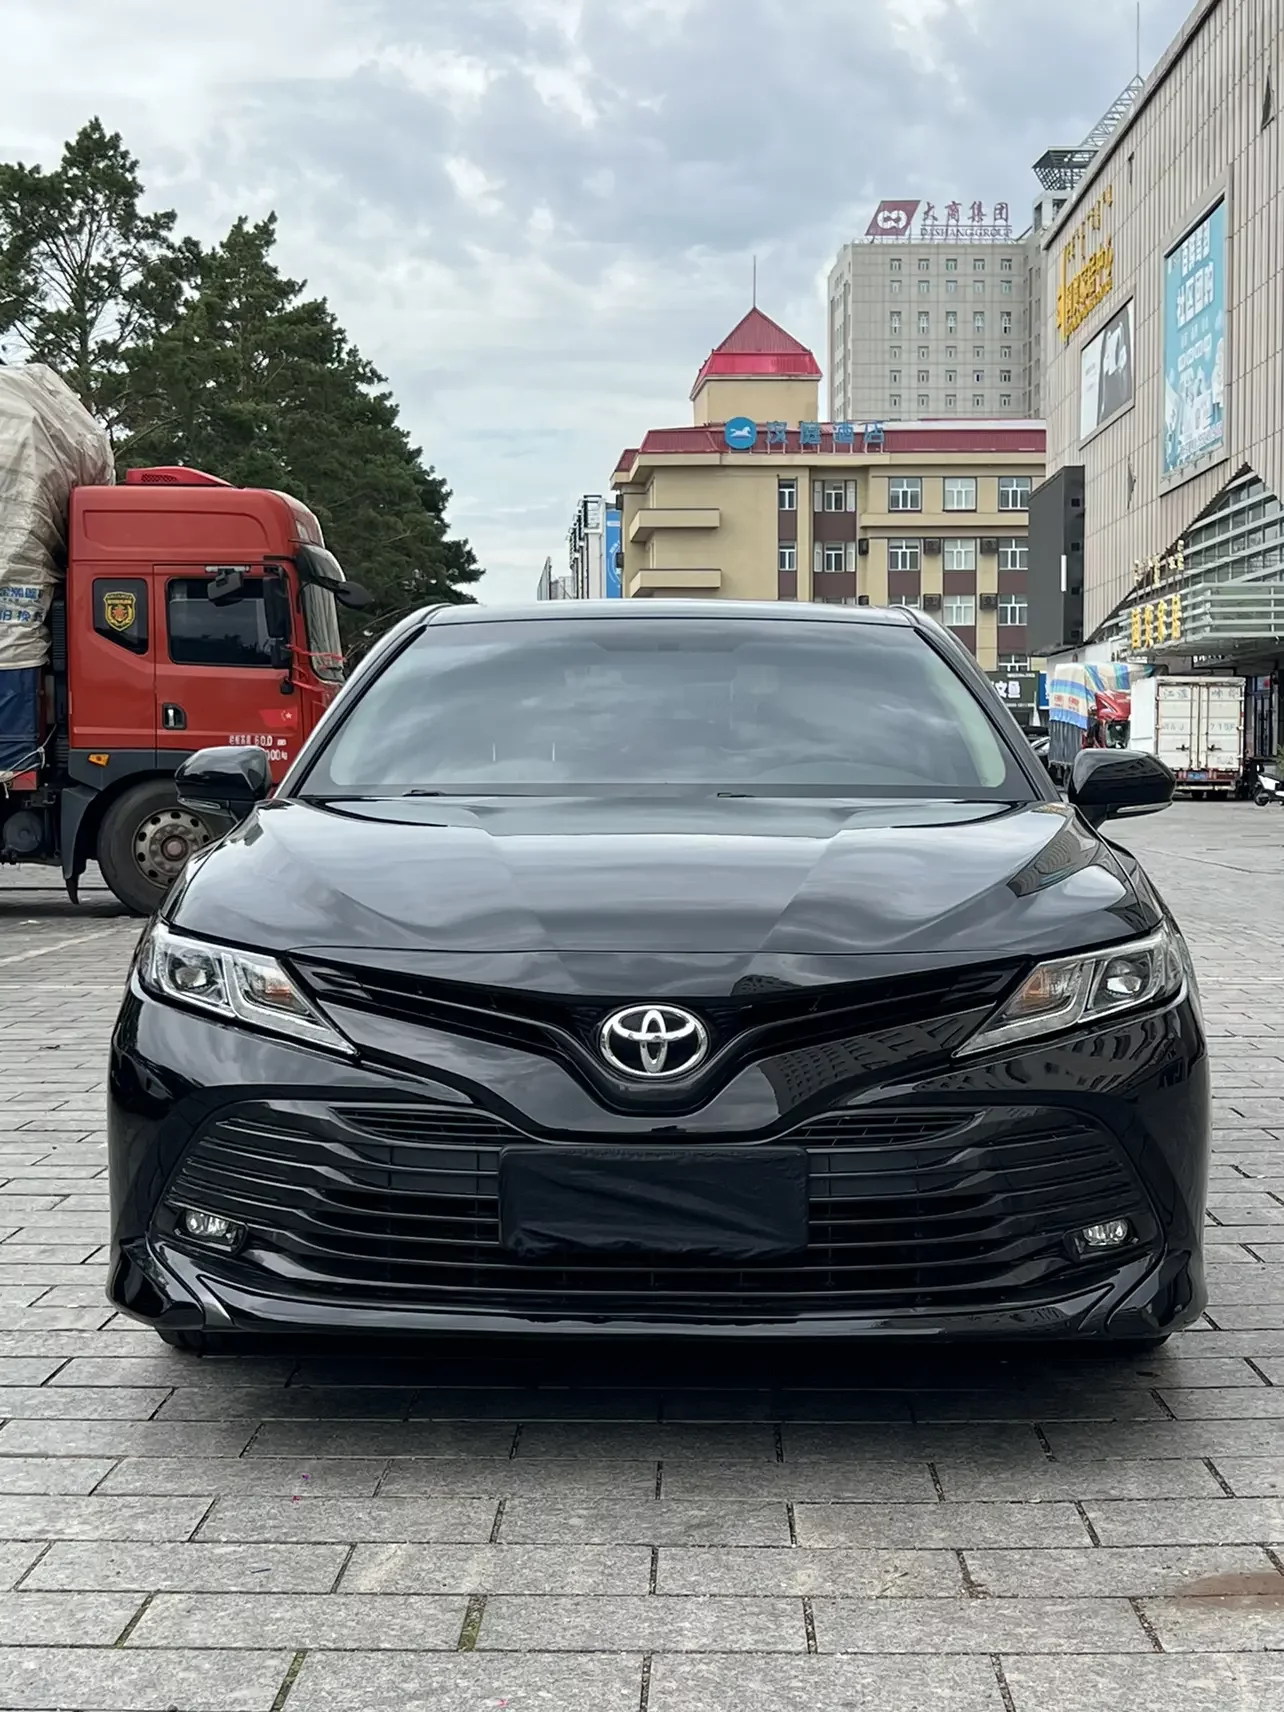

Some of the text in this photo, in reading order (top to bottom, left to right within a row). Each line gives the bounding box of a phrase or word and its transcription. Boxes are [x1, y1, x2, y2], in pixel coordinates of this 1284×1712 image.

[922, 201, 1010, 223] 大商集团
[974, 227, 1013, 238] GROUP
[766, 421, 885, 444] 汉庭酒店
